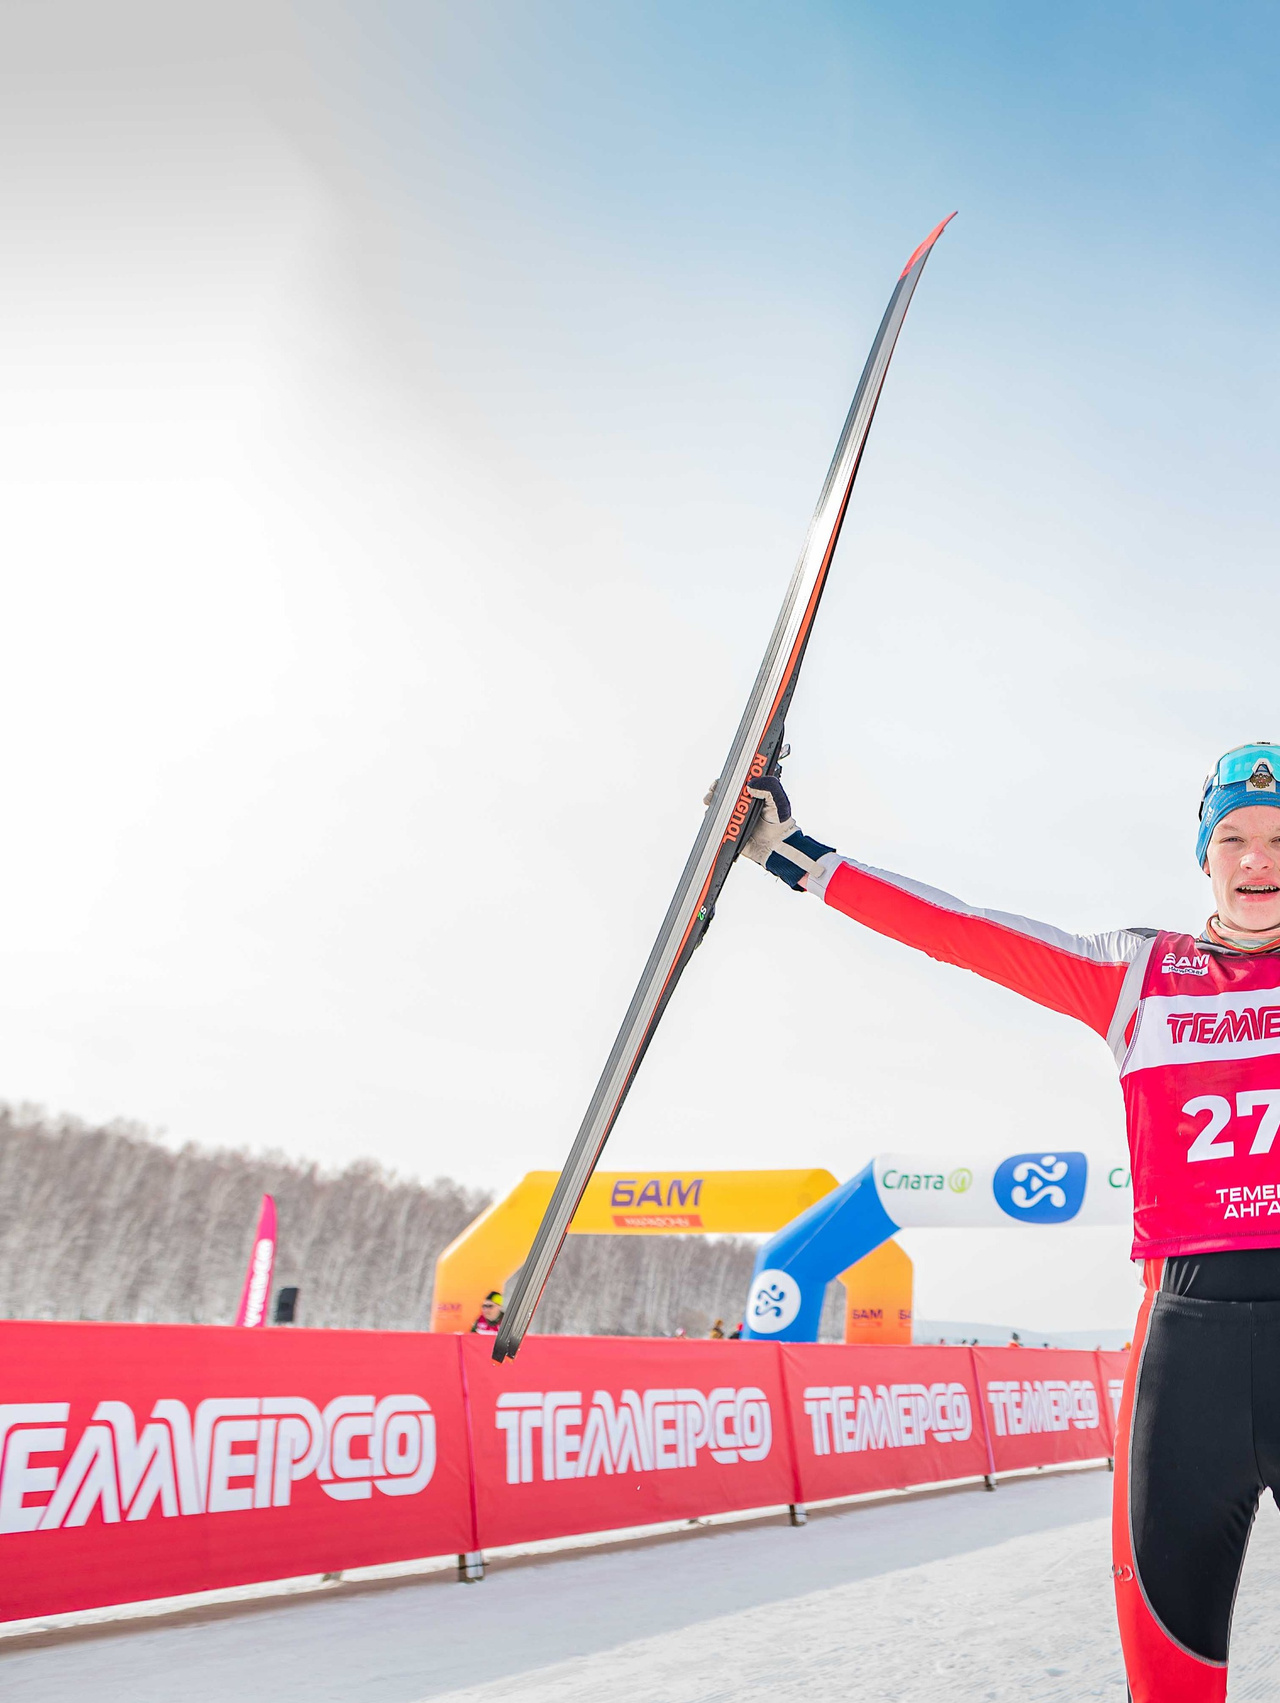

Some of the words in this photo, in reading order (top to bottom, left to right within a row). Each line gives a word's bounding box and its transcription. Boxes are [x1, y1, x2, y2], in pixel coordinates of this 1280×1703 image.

[721, 753, 768, 843] ROSIGNOL
[697, 905, 707, 921] S2
[611, 1179, 704, 1207] БАМ
[882, 1169, 945, 1191] Слата
[495, 1387, 773, 1485] ТЕМЕРСО
[803, 1382, 973, 1456] ТЕМЕРСО
[987, 1380, 1100, 1437] ТЕМЕРСО
[0, 1393, 437, 1534] ЕМЕРСО
